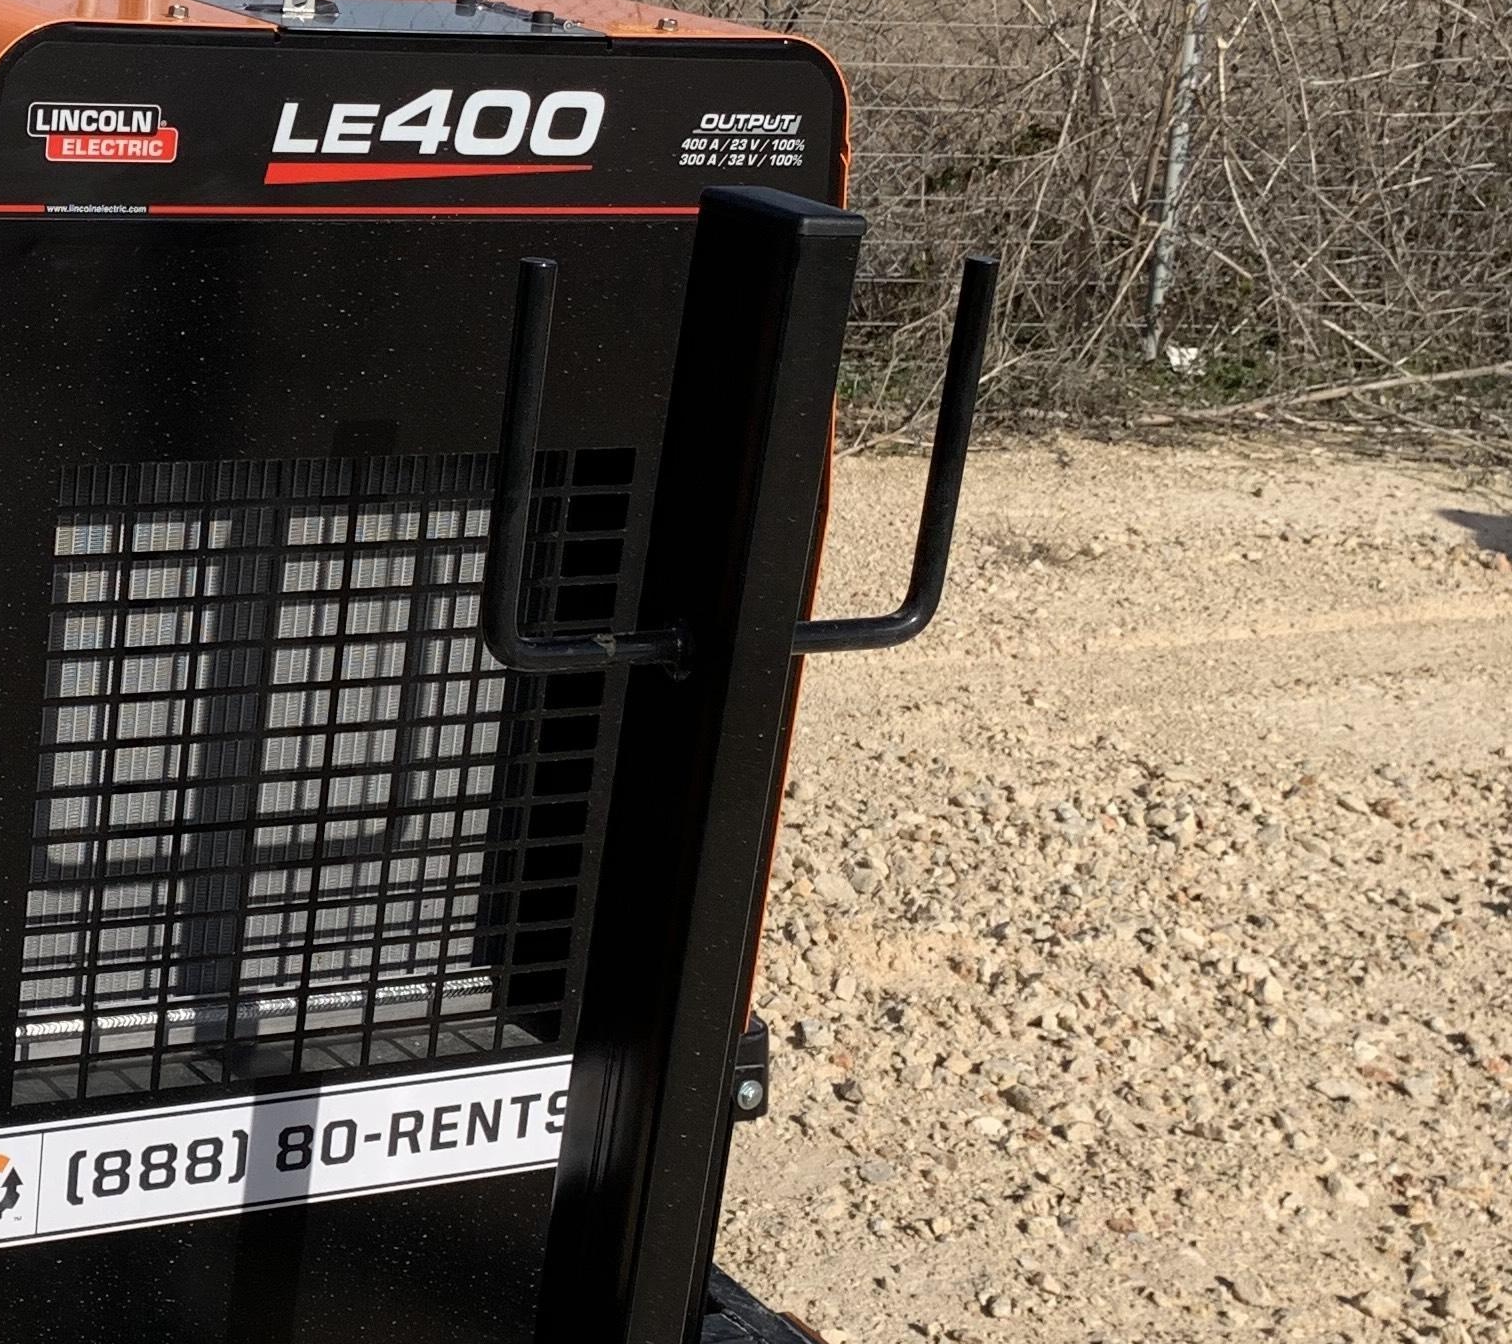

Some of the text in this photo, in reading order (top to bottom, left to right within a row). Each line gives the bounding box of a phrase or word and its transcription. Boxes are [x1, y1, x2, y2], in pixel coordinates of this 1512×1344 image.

[36, 109, 152, 133] LINCOLN
[272, 89, 605, 156] LE400
[700, 113, 796, 130] OUTPUT
[62, 138, 163, 156] ELECTRIC
[681, 138, 708, 151] 400
[709, 138, 719, 151] A
[730, 139, 748, 151] 23
[750, 139, 760, 151] V
[772, 139, 805, 152] 100%
[679, 154, 706, 166] 300
[707, 154, 717, 166] A
[728, 154, 745, 166] 32
[748, 154, 758, 166] V
[770, 154, 803, 166] 100%
[47, 204, 147, 214] www.lincolnelectric.com
[67, 1131, 249, 1206] (888)
